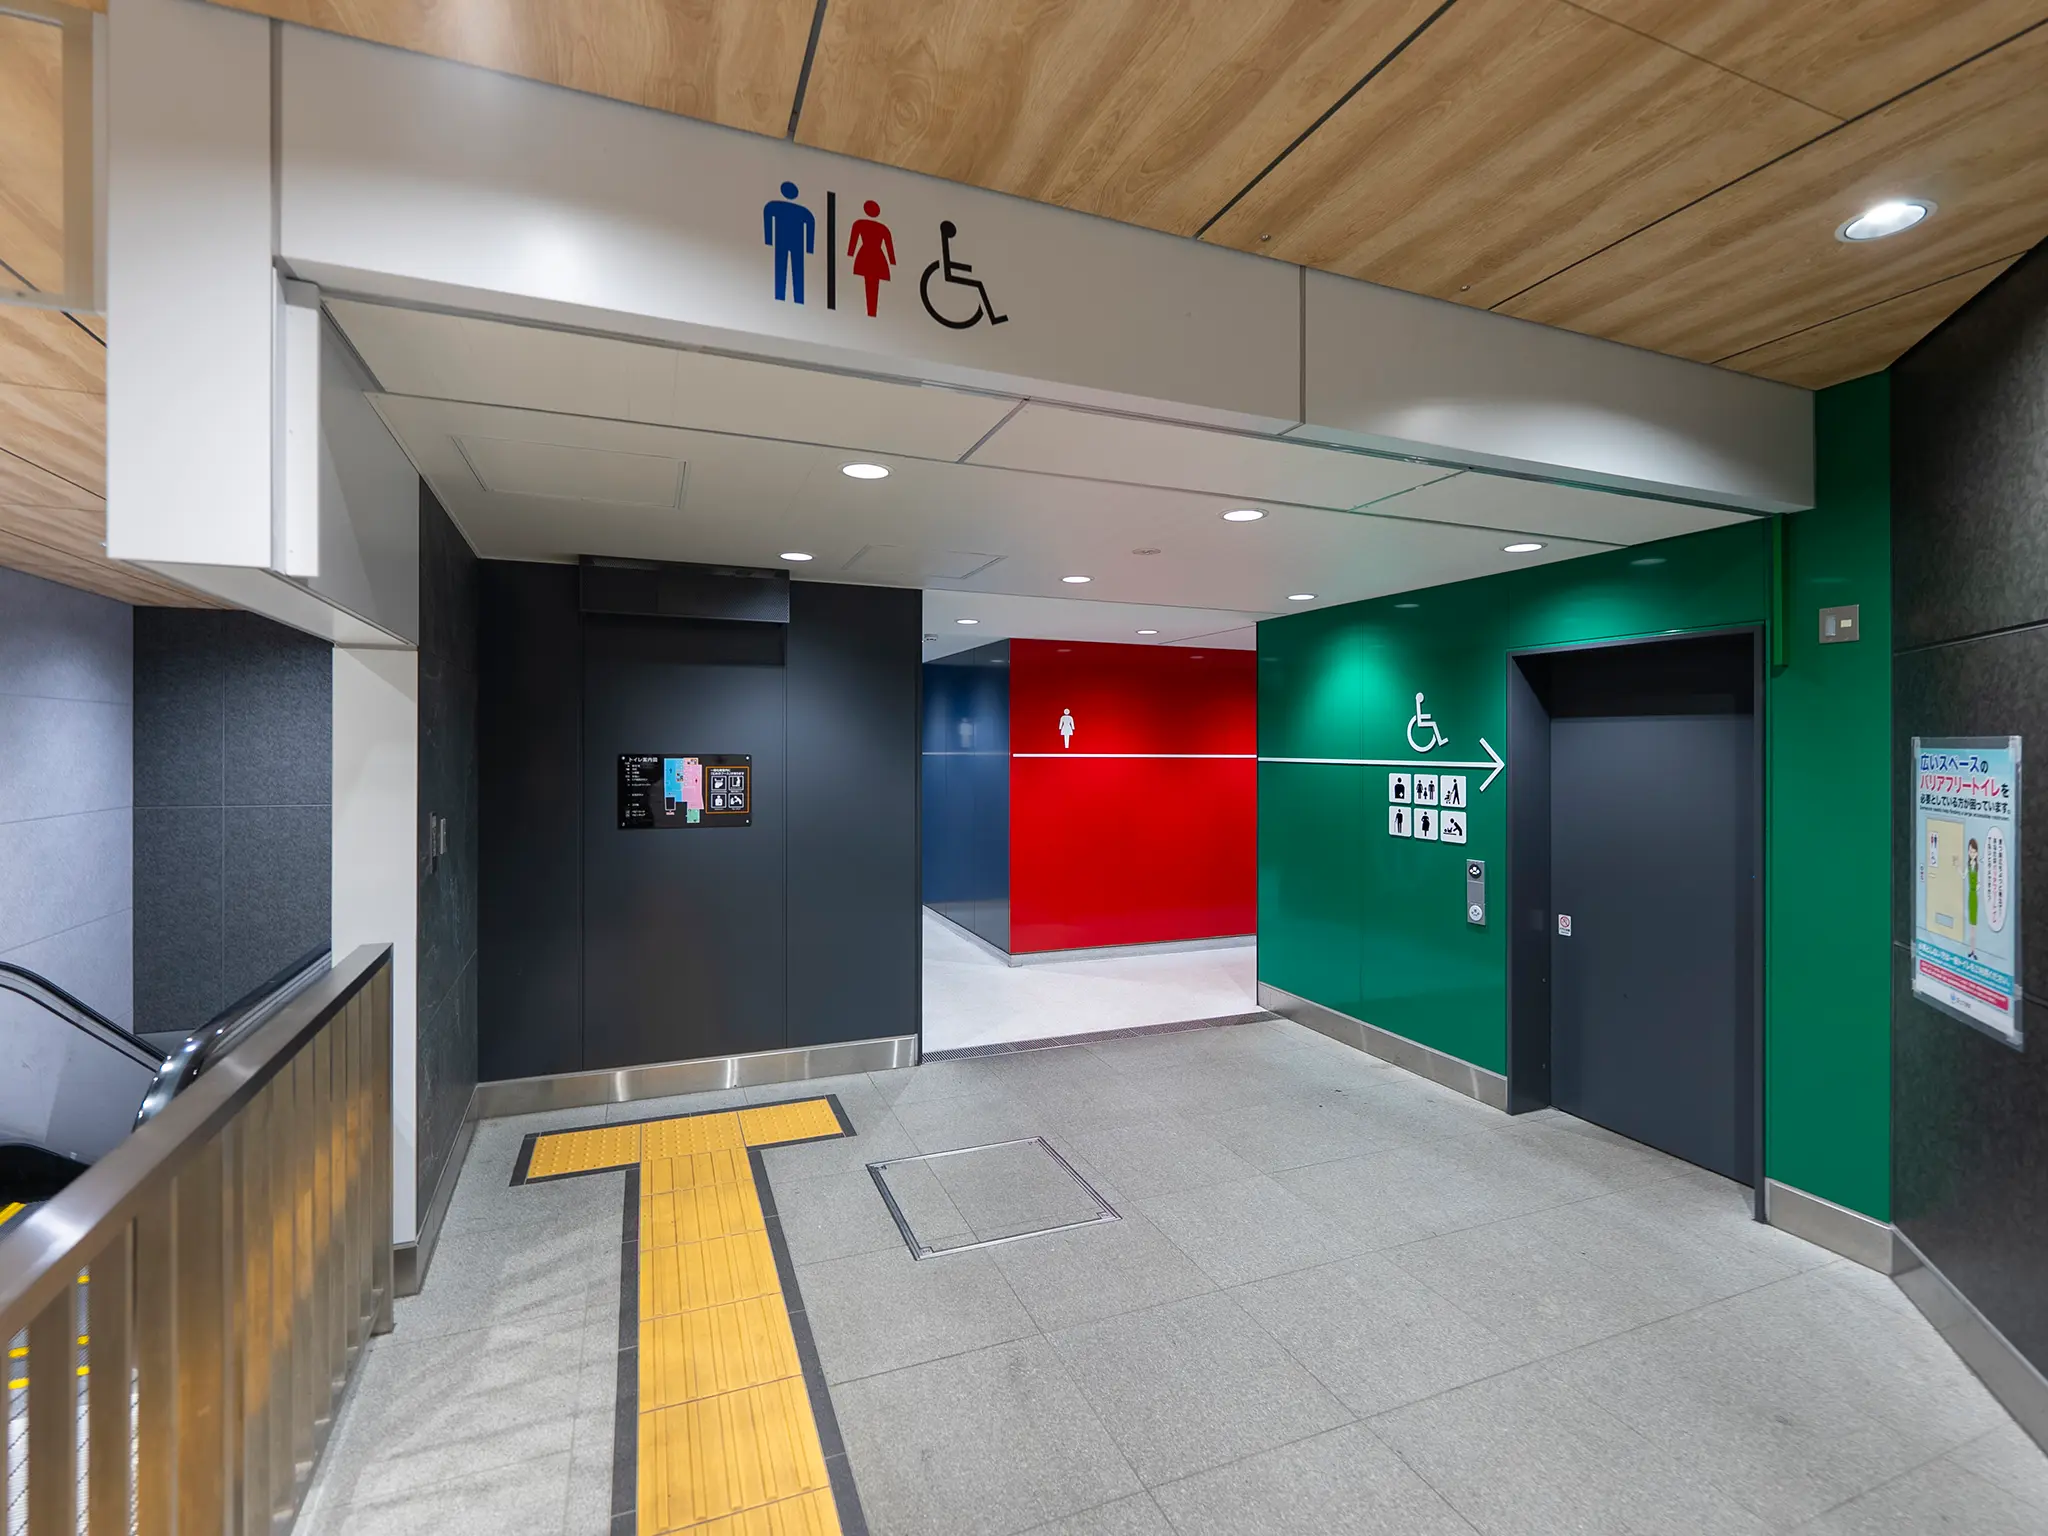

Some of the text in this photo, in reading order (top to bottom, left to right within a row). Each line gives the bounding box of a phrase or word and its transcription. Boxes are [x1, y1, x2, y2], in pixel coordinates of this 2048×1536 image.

[1920, 754, 1988, 774] 広いスペースの
[1920, 775, 2010, 798] バリアフリートイレを
[1920, 793, 2011, 814] 必要としている方が困っています。
